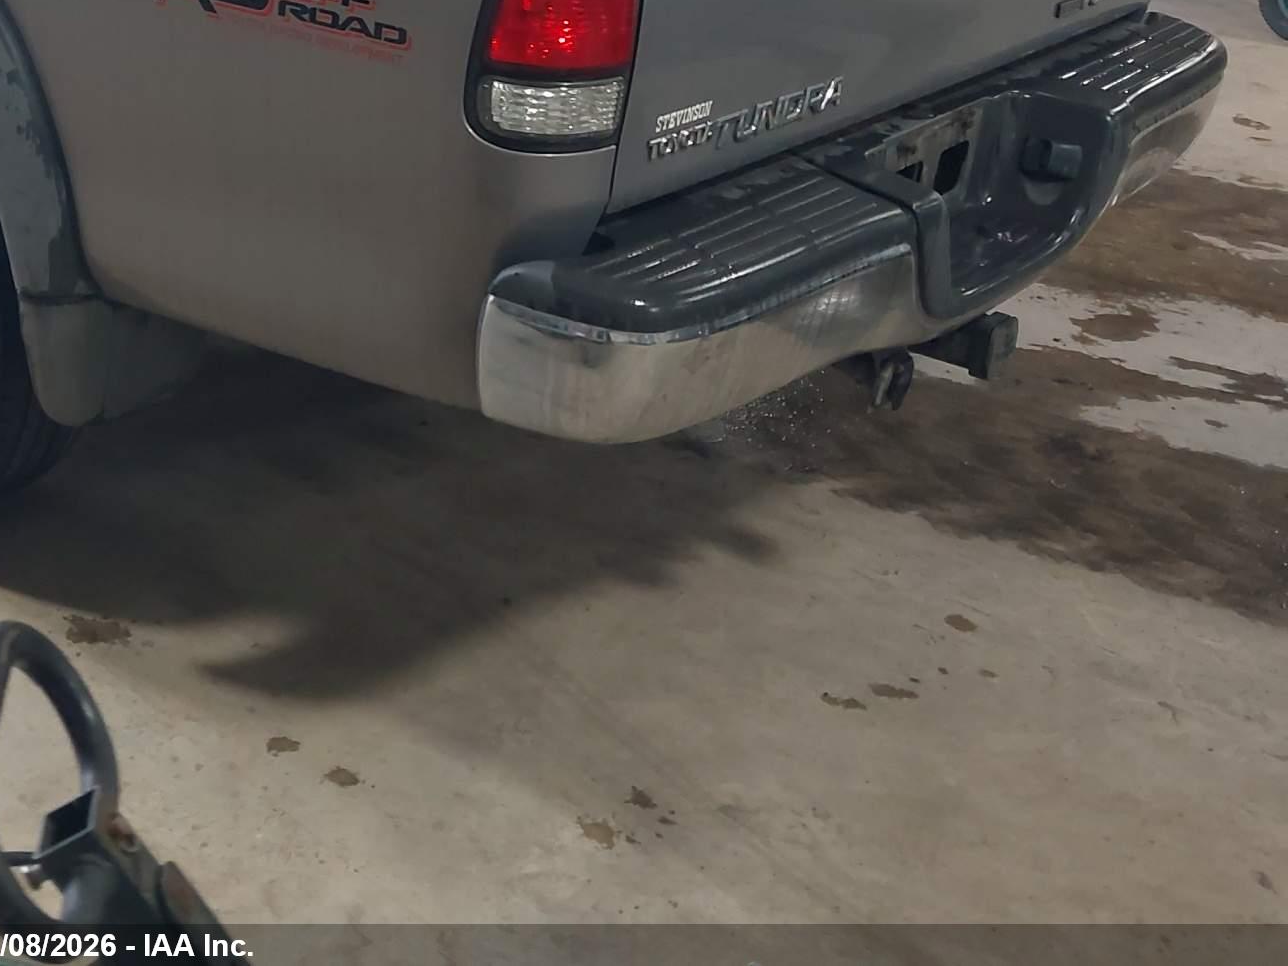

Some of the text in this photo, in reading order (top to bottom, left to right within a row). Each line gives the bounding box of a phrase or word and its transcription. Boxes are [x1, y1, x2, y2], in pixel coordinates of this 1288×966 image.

[277, 0, 409, 47] ROAD
[655, 100, 713, 133] STEVINSON
[713, 75, 844, 149] TUNDRA
